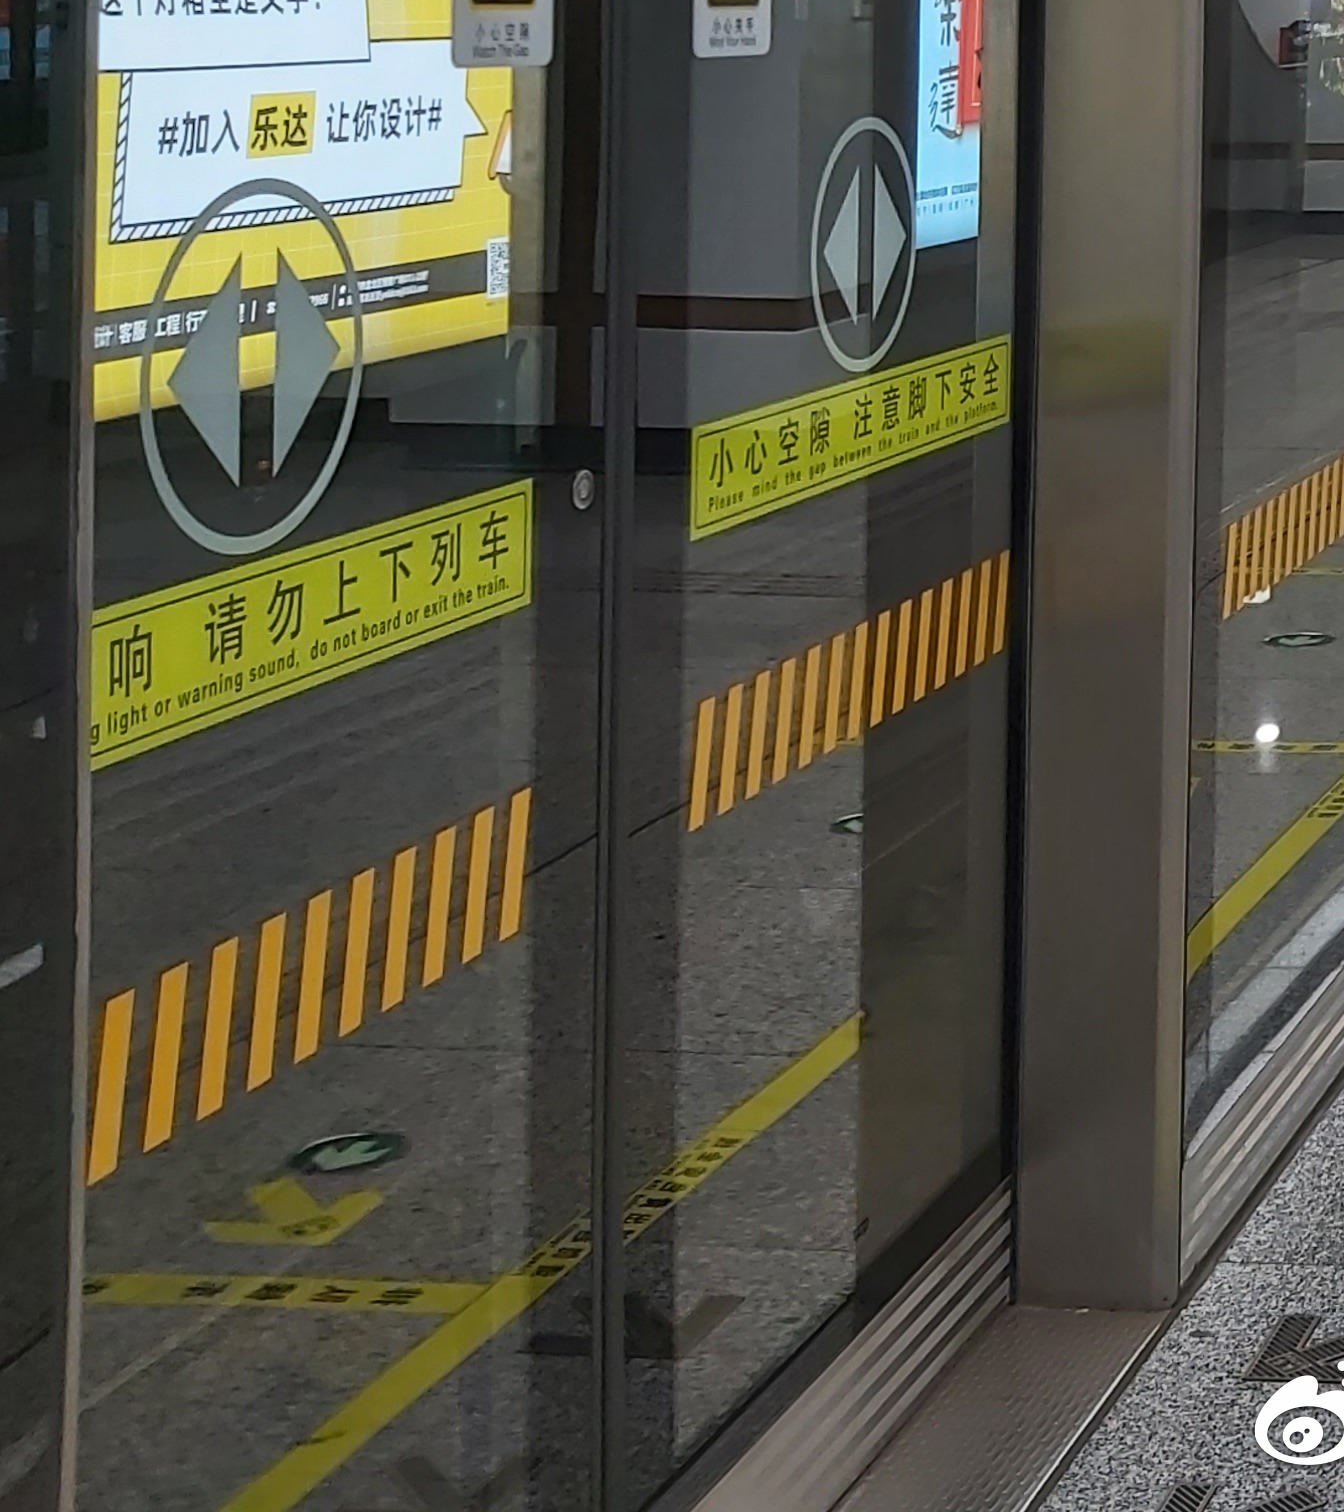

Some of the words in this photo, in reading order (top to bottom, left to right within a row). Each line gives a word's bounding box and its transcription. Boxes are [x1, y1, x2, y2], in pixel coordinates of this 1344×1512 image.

[157, 108, 240, 158] #加入
[250, 104, 309, 152] 乐达
[326, 95, 443, 145] 让你设计#
[707, 489, 744, 513] Please
[752, 477, 778, 498] mind
[785, 467, 802, 483] the
[878, 436, 893, 452] the
[925, 418, 941, 436] and
[945, 410, 959, 428] the
[709, 406, 831, 488] 小心空隙
[853, 353, 1000, 440] 注意脚下安全
[107, 699, 148, 736] light
[153, 695, 171, 717] or
[177, 672, 244, 711] warning
[248, 649, 300, 684] sound,
[310, 638, 328, 661] do
[333, 627, 357, 653] not
[361, 610, 401, 643] board
[405, 605, 420, 627] or
[423, 594, 448, 619] exit
[452, 582, 473, 607] the
[477, 574, 510, 600] train.
[109, 623, 153, 698] 响
[204, 510, 510, 665] 请勿上下列车
